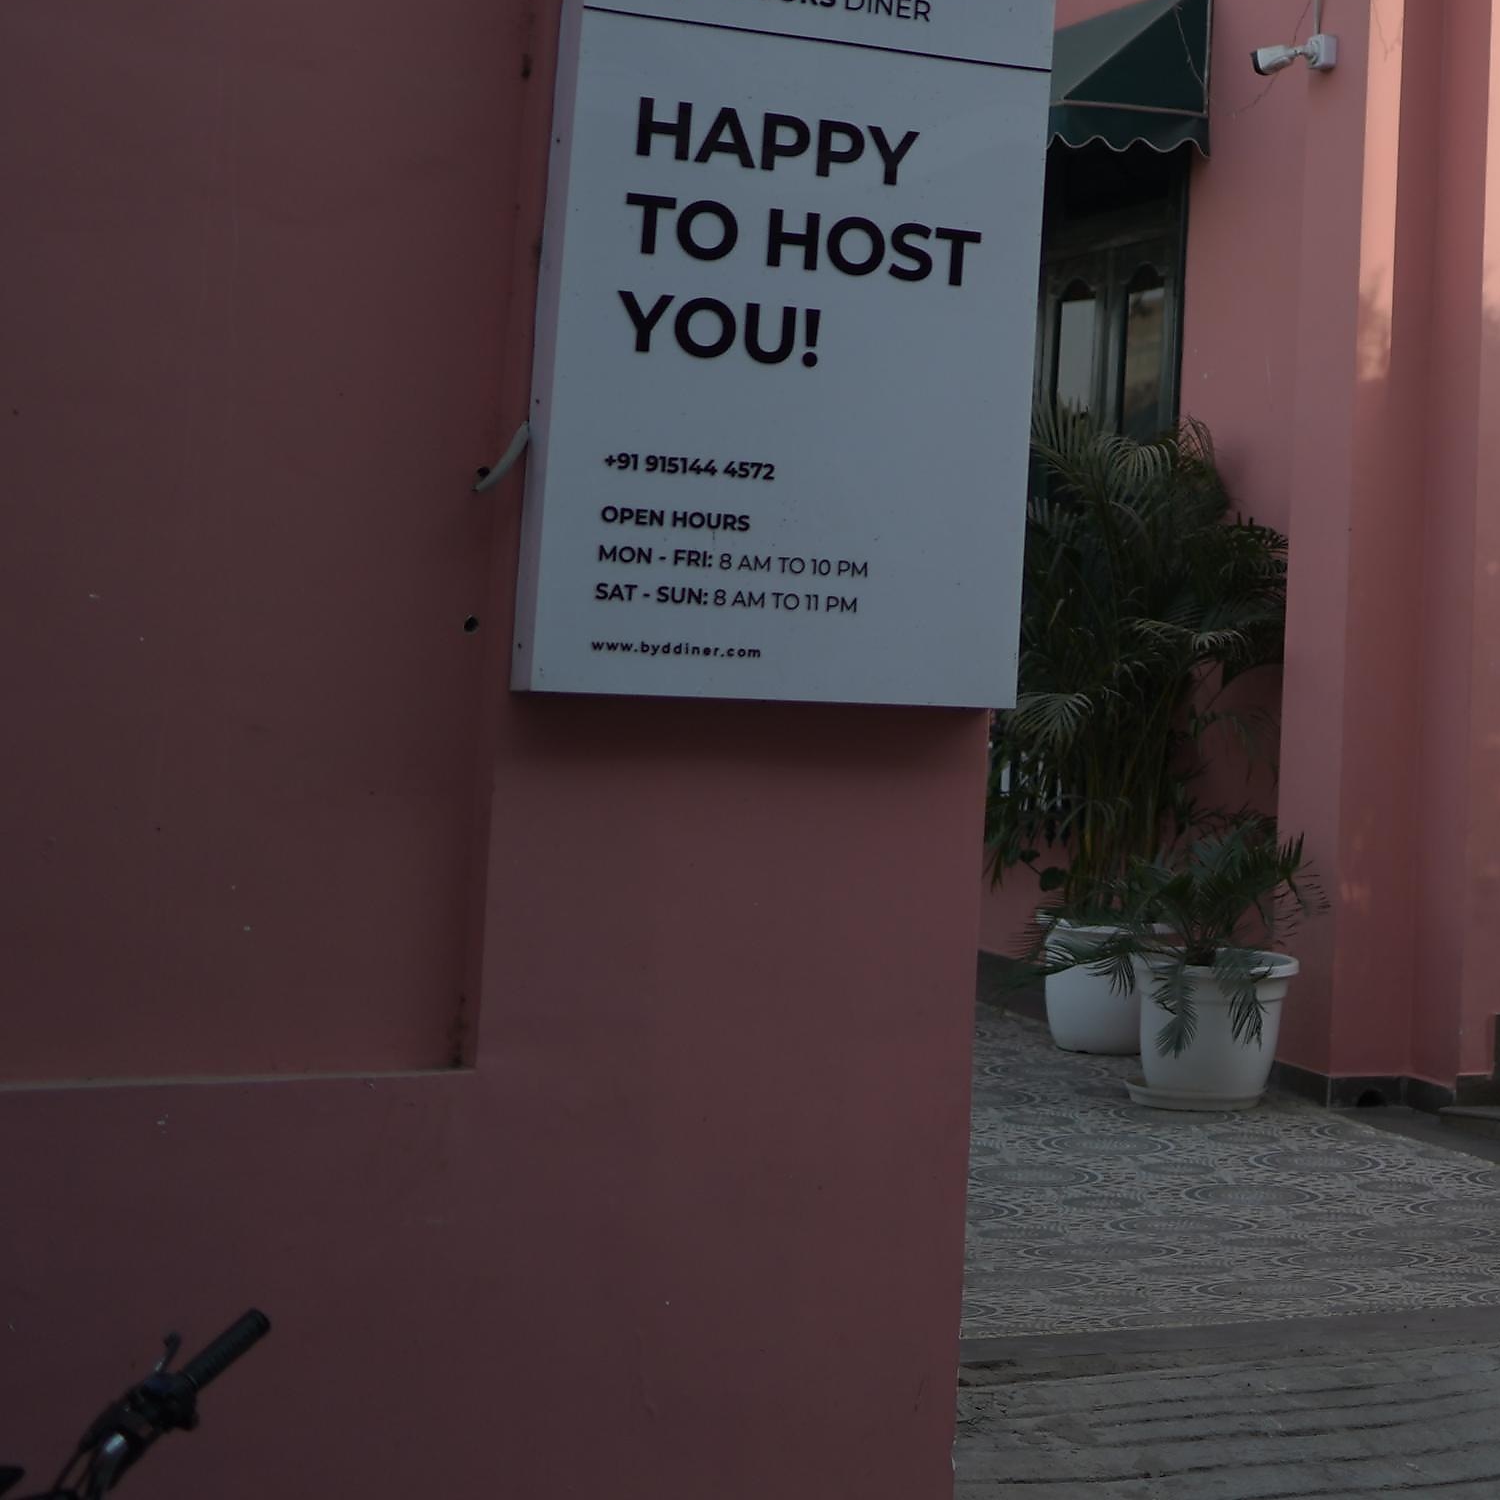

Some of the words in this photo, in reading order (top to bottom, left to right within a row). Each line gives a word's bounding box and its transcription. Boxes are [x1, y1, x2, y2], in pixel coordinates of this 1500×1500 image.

[635, 96, 920, 186] HAPPY
[626, 193, 738, 261] TO
[766, 209, 981, 287] HOST
[618, 290, 822, 368] YOU!
[604, 453, 638, 470] +91
[645, 455, 718, 476] 915144
[723, 461, 775, 481] 4572
[601, 506, 664, 526] OPEN
[672, 511, 750, 531] HOURS
[598, 545, 652, 564] MON
[674, 550, 713, 568] FRI:
[720, 553, 732, 570] 8
[738, 555, 771, 572] AM
[778, 557, 805, 574] TO
[811, 559, 831, 575] 10
[837, 560, 868, 578] PM
[595, 583, 638, 601] SAT
[657, 586, 708, 605] SUN:
[713, 589, 726, 606] 8
[732, 591, 765, 608] AM
[772, 592, 799, 610] TO
[806, 594, 819, 611] 11
[826, 596, 857, 613] PM
[591, 640, 761, 658] www.byddiner.com
